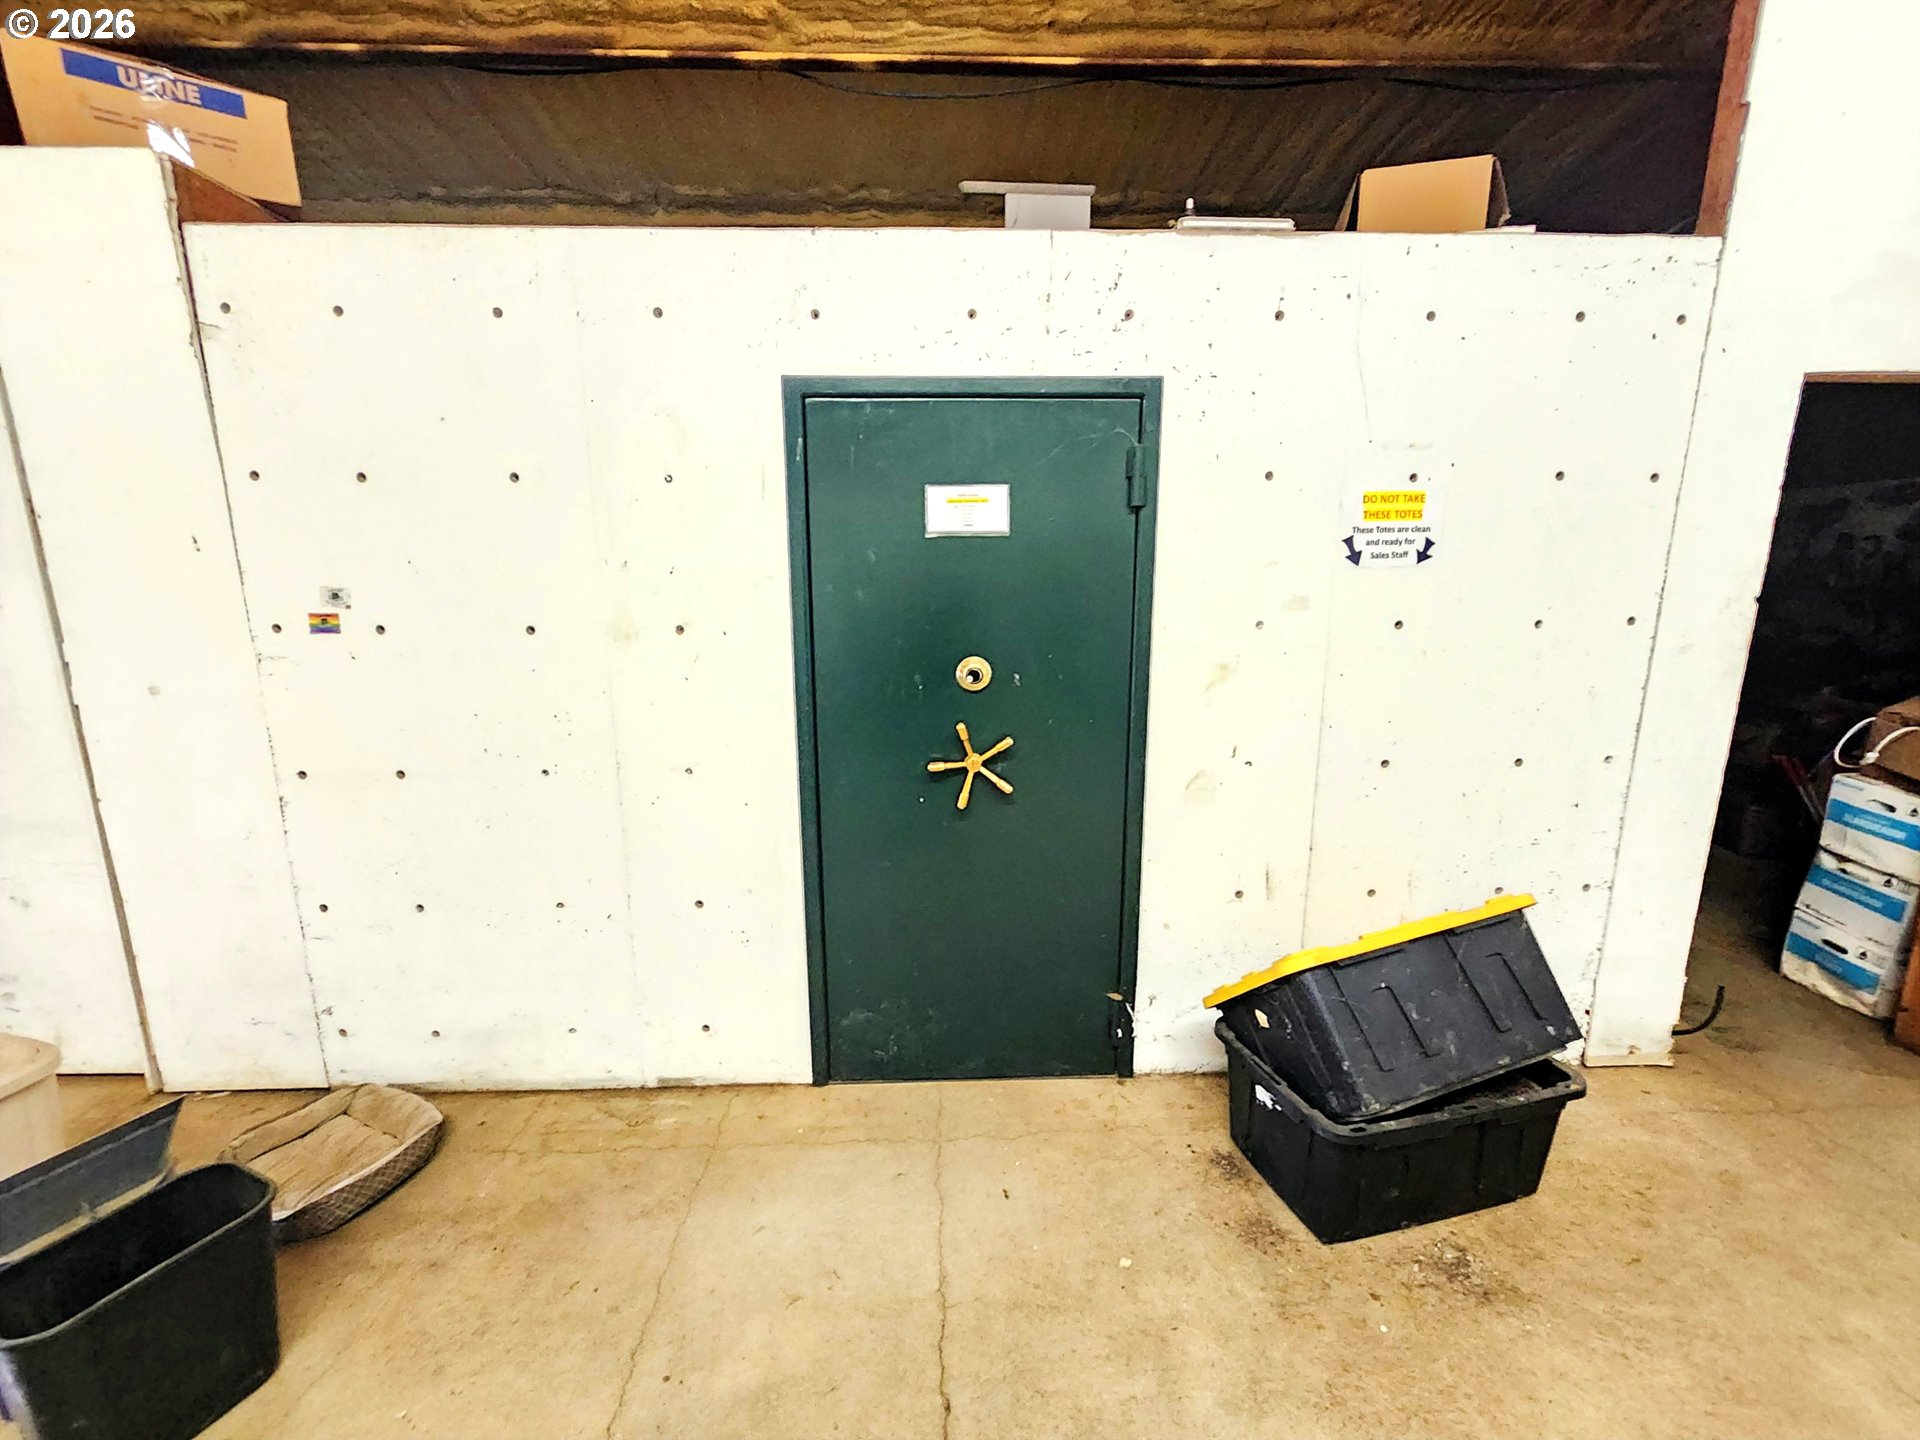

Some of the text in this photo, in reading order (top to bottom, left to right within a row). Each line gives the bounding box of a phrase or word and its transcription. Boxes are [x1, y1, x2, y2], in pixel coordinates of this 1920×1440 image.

[1363, 493, 1426, 504] DO NOT TAKE
[1363, 509, 1423, 520] THESE TOTES
[1352, 526, 1374, 534] These
[1376, 525, 1396, 533] Totes
[1411, 525, 1431, 533] clean
[1381, 538, 1403, 547] ready
[1404, 537, 1416, 545] for
[1391, 550, 1409, 559] Staff
